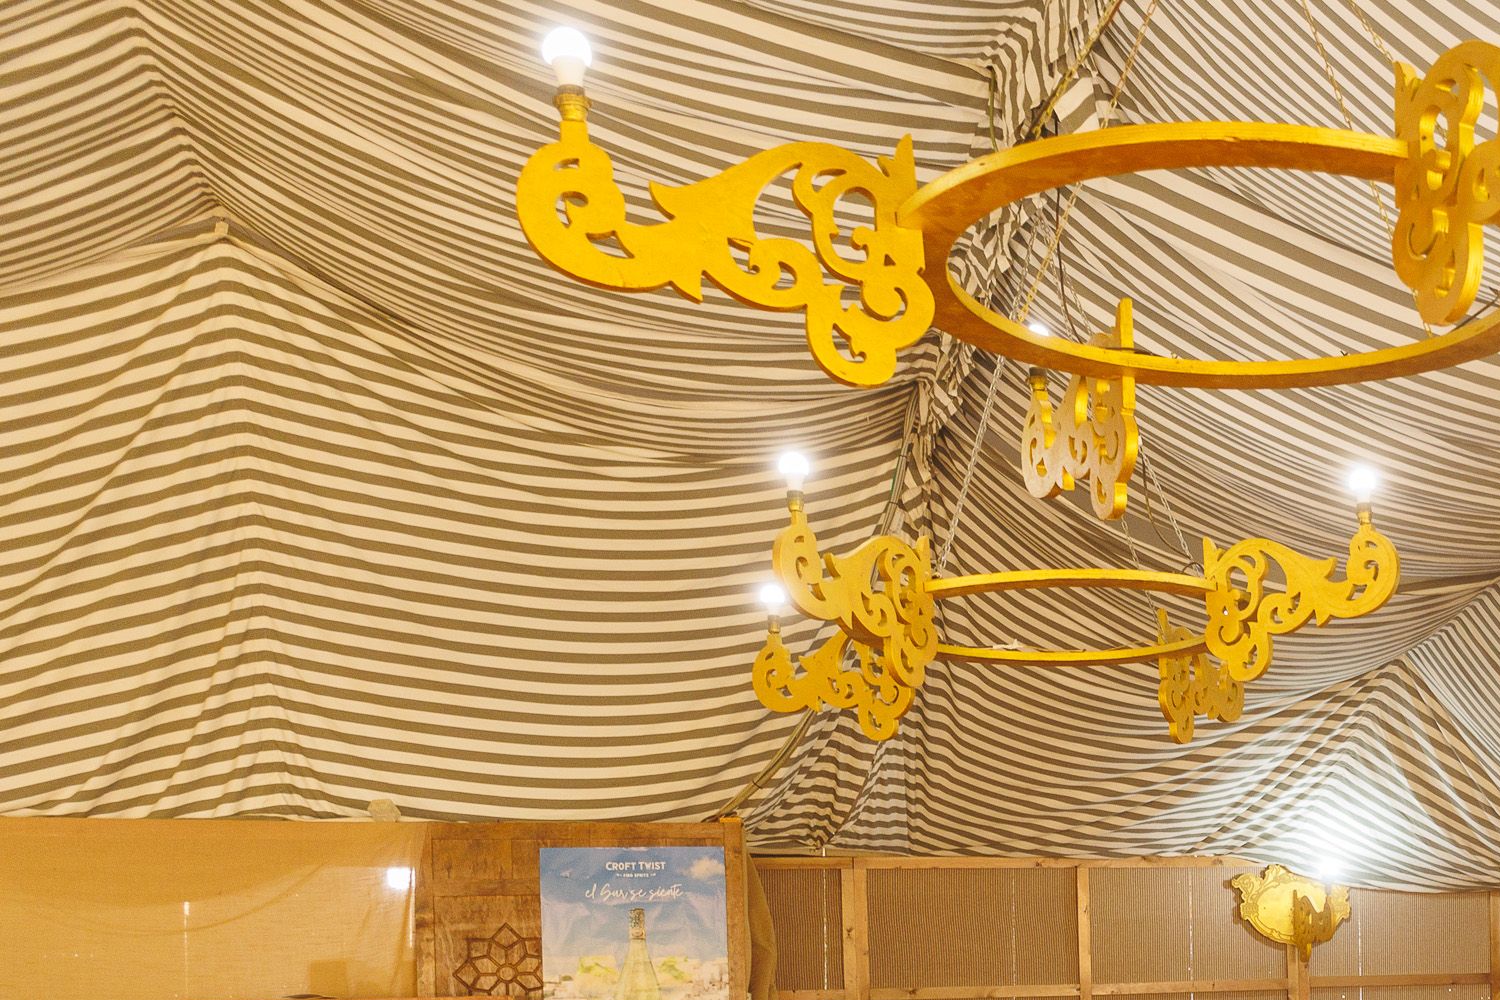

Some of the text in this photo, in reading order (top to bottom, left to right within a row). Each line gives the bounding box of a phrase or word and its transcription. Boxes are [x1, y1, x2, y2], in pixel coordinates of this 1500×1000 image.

[605, 861, 667, 871] CROFT TWIST
[585, 883, 683, 901] el Sur se siente
